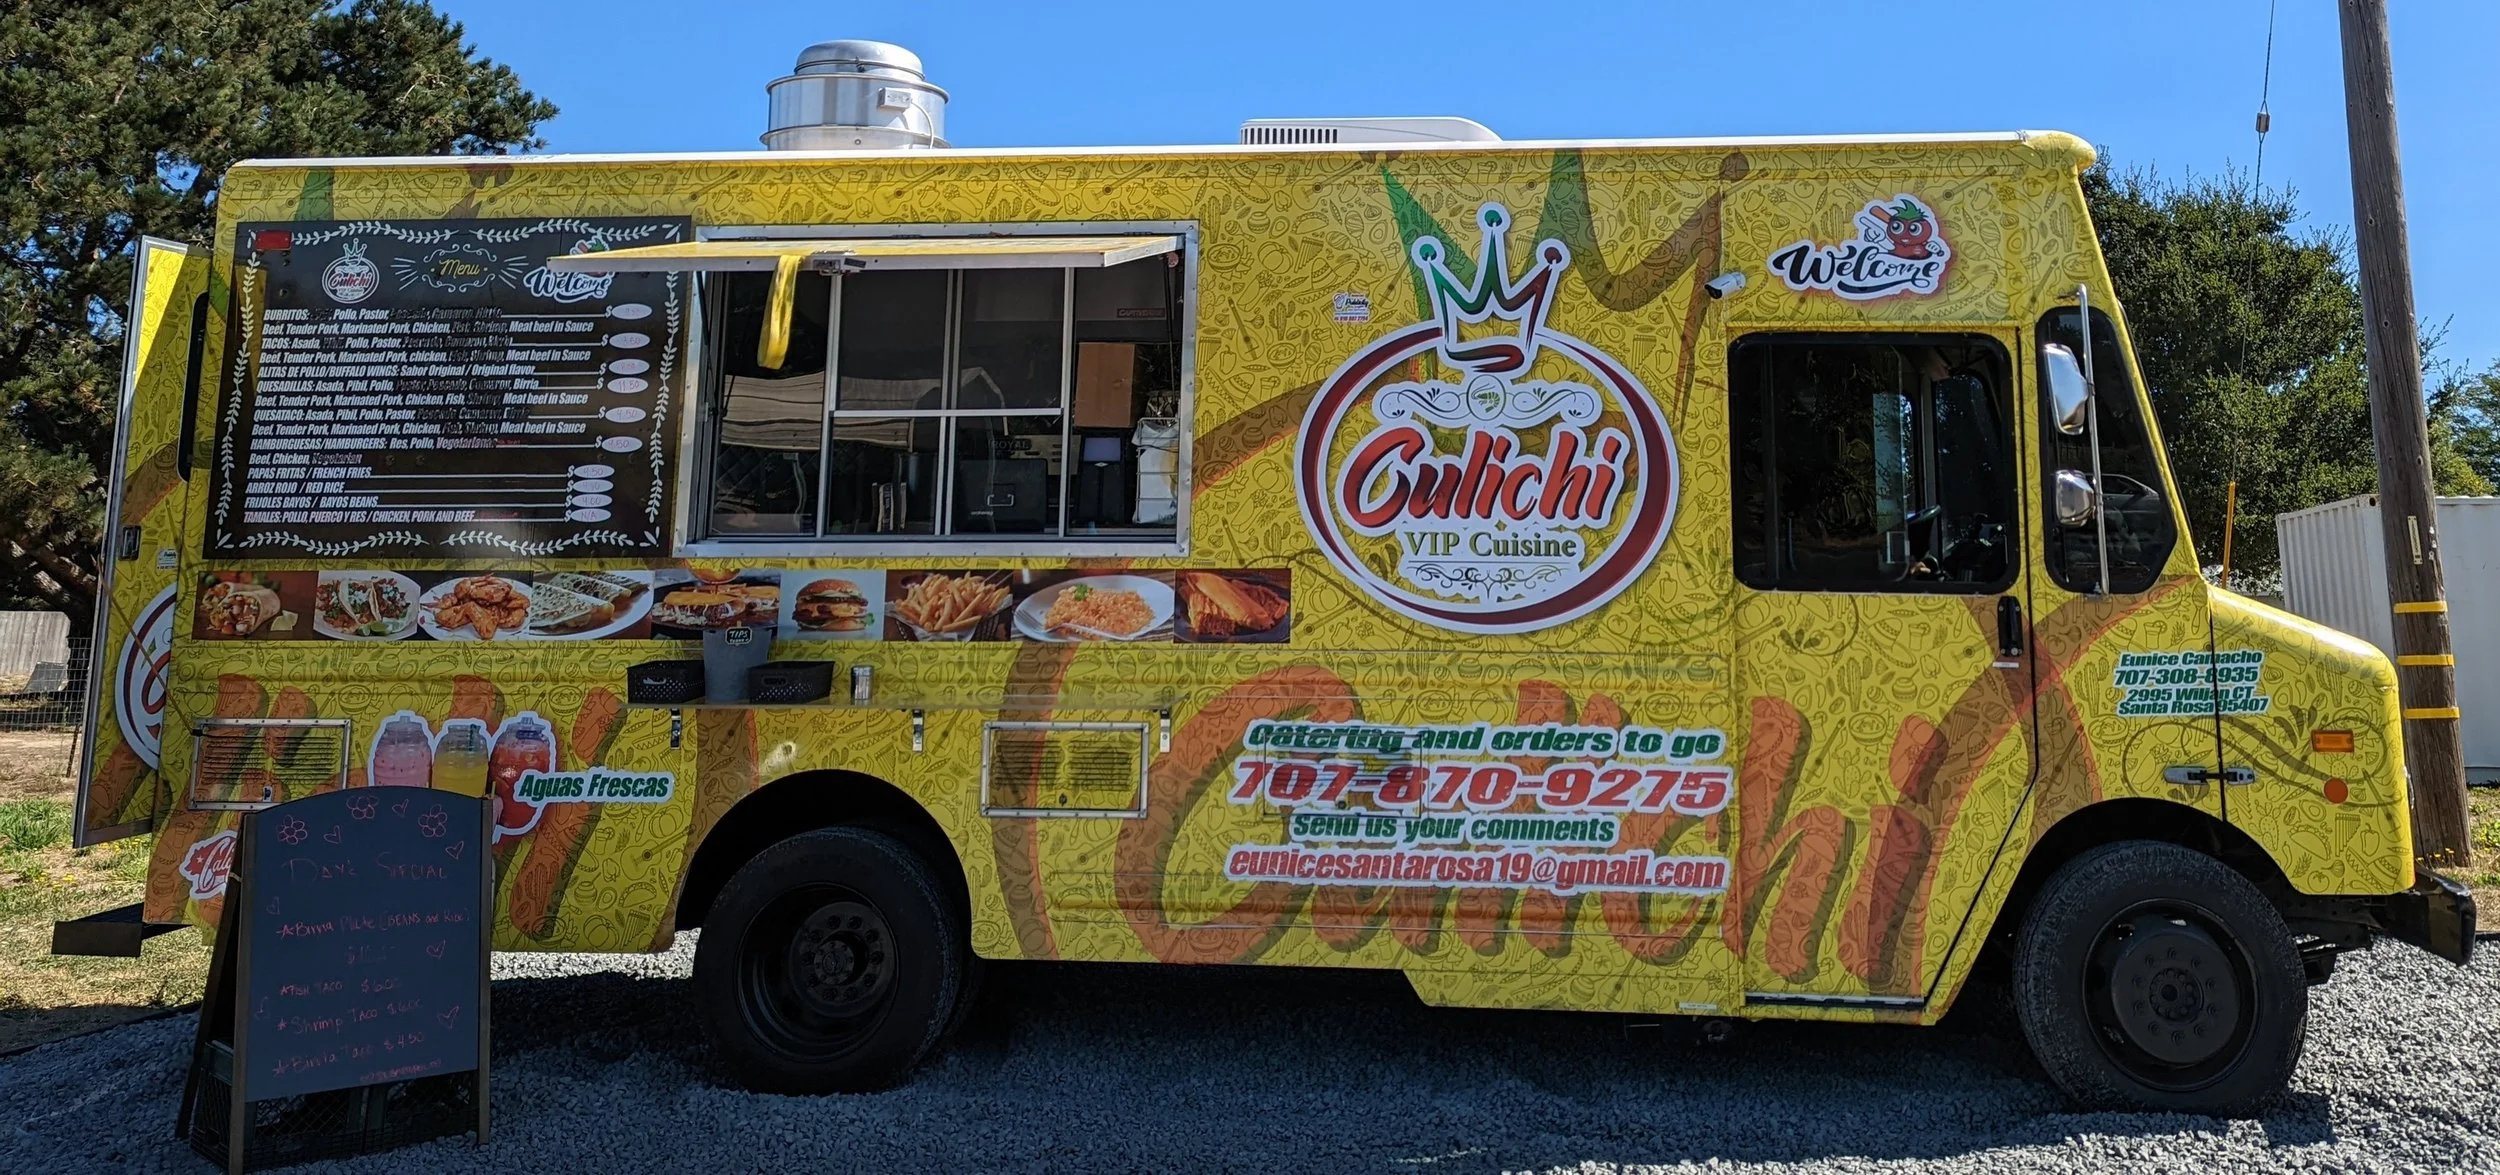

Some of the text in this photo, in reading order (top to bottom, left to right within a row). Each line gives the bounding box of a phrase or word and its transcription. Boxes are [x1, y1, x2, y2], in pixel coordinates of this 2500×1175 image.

[439, 259, 480, 278] Menu
[1772, 245, 1939, 294] Welcome
[525, 268, 611, 300] Welcome
[263, 309, 310, 320] BURRITOS:
[333, 308, 357, 320] Pollo,
[359, 308, 389, 320] Pastor,
[262, 323, 284, 335] Beef,
[286, 323, 318, 334] Tender
[318, 323, 340, 335] Pork,
[340, 322, 387, 334] Marinated
[388, 322, 410, 335] Pork,
[412, 322, 450, 334] Chicken,
[509, 321, 533, 333] Meat
[533, 321, 554, 333] beef
[554, 321, 564, 332] in
[564, 321, 594, 332] Sauce
[261, 338, 291, 349] TACOS:
[291, 338, 320, 350] Asada,
[345, 337, 369, 349] Pollo,
[370, 337, 401, 349] Pastor,
[259, 353, 281, 365] Beef,
[283, 352, 315, 364] Tender
[315, 352, 337, 364] Pork,
[338, 352, 385, 363] Marinated
[385, 351, 408, 364] Pork,
[506, 350, 530, 362] Meat
[530, 350, 551, 362] beef
[552, 350, 561, 361] in
[562, 350, 591, 361] Sauce
[257, 366, 288, 377] ALITAS
[288, 366, 299, 377] DE
[300, 366, 366, 377] POLLO/BUFFALO
[367, 365, 399, 376] WINGS:
[400, 365, 428, 376] Sabor
[428, 364, 467, 377] Original
[471, 364, 510, 376] Original
[509, 364, 535, 375] flavor
[256, 381, 315, 393] QUESADILLAS:
[315, 380, 344, 393] Asada,
[345, 380, 368, 392] Pibil,
[369, 380, 394, 392] Pollo,
[255, 396, 277, 408] Beef,
[279, 395, 310, 407] Tender
[310, 395, 332, 407] Pork,
[334, 395, 381, 406] Marinated
[381, 395, 403, 407] Pork,
[405, 394, 443, 407] Chicken,
[445, 394, 465, 406] Fish,
[503, 394, 525, 405] Meat
[525, 393, 547, 405] beef
[548, 393, 559, 404] in
[560, 393, 588, 404] Sauce
[254, 410, 305, 422] QUESATACO:
[305, 409, 334, 422] Asada,
[335, 409, 358, 421] Pibil,
[359, 409, 384, 421] Pollo,
[385, 408, 415, 421] Pastor,
[252, 424, 274, 437] Beef,
[275, 424, 307, 435] Tender
[307, 424, 329, 436] Pork,
[330, 424, 378, 435] Marinated
[378, 423, 401, 436] Pork,
[402, 423, 440, 435] Chicken,
[500, 422, 523, 434] Meat
[524, 422, 545, 433] beef
[546, 422, 556, 433] in
[556, 422, 586, 433] Sauce
[250, 438, 387, 450] HAMBURGUESAS/HAMBURGERS:
[390, 438, 408, 450] Res,
[410, 438, 435, 450] Pollo,
[249, 453, 271, 466] Beef,
[272, 453, 310, 466] Chicken,
[247, 468, 276, 479] PAPAS
[276, 468, 306, 479] FRITAS
[313, 467, 347, 479] FRENCH
[347, 467, 373, 478] FRIES
[1342, 426, 1623, 528] Culichi
[245, 482, 275, 494] ARROZ
[275, 482, 298, 493] ROJO
[305, 482, 323, 493] RED
[323, 482, 345, 493] RICE
[244, 497, 283, 508] FRIJOLES
[283, 497, 312, 508] BAYOS
[320, 497, 349, 508] BAYOS
[349, 496, 378, 508] BEANS
[281, 511, 308, 524] POLLO,
[309, 511, 342, 523] PUERCO
[350, 511, 367, 522] RES
[373, 511, 410, 523] CHICKEN,
[410, 511, 438, 522] PORK
[436, 511, 453, 522] AND
[453, 511, 475, 522] BEEF
[1404, 530, 1577, 557] VIP Cuisine
[729, 630, 748, 638] TIPS
[2121, 651, 2262, 667] Eunice Camacho
[2115, 667, 2258, 686] 707-308-8935
[2127, 688, 2172, 701] 2995
[2232, 686, 2254, 699] CT
[2119, 698, 2269, 715] Santa Rosa 95407
[1249, 724, 1721, 757] Catering and orders to go
[518, 774, 670, 801] Aguas Frescas
[1232, 761, 1728, 810] 707-870-9275
[1365, 817, 1397, 837] us
[1404, 817, 1467, 841] your
[1471, 817, 1616, 842] comments
[1229, 849, 1726, 890] eunicesantarosa19@gmail.com
[291, 1015, 343, 1036] Shrimp
